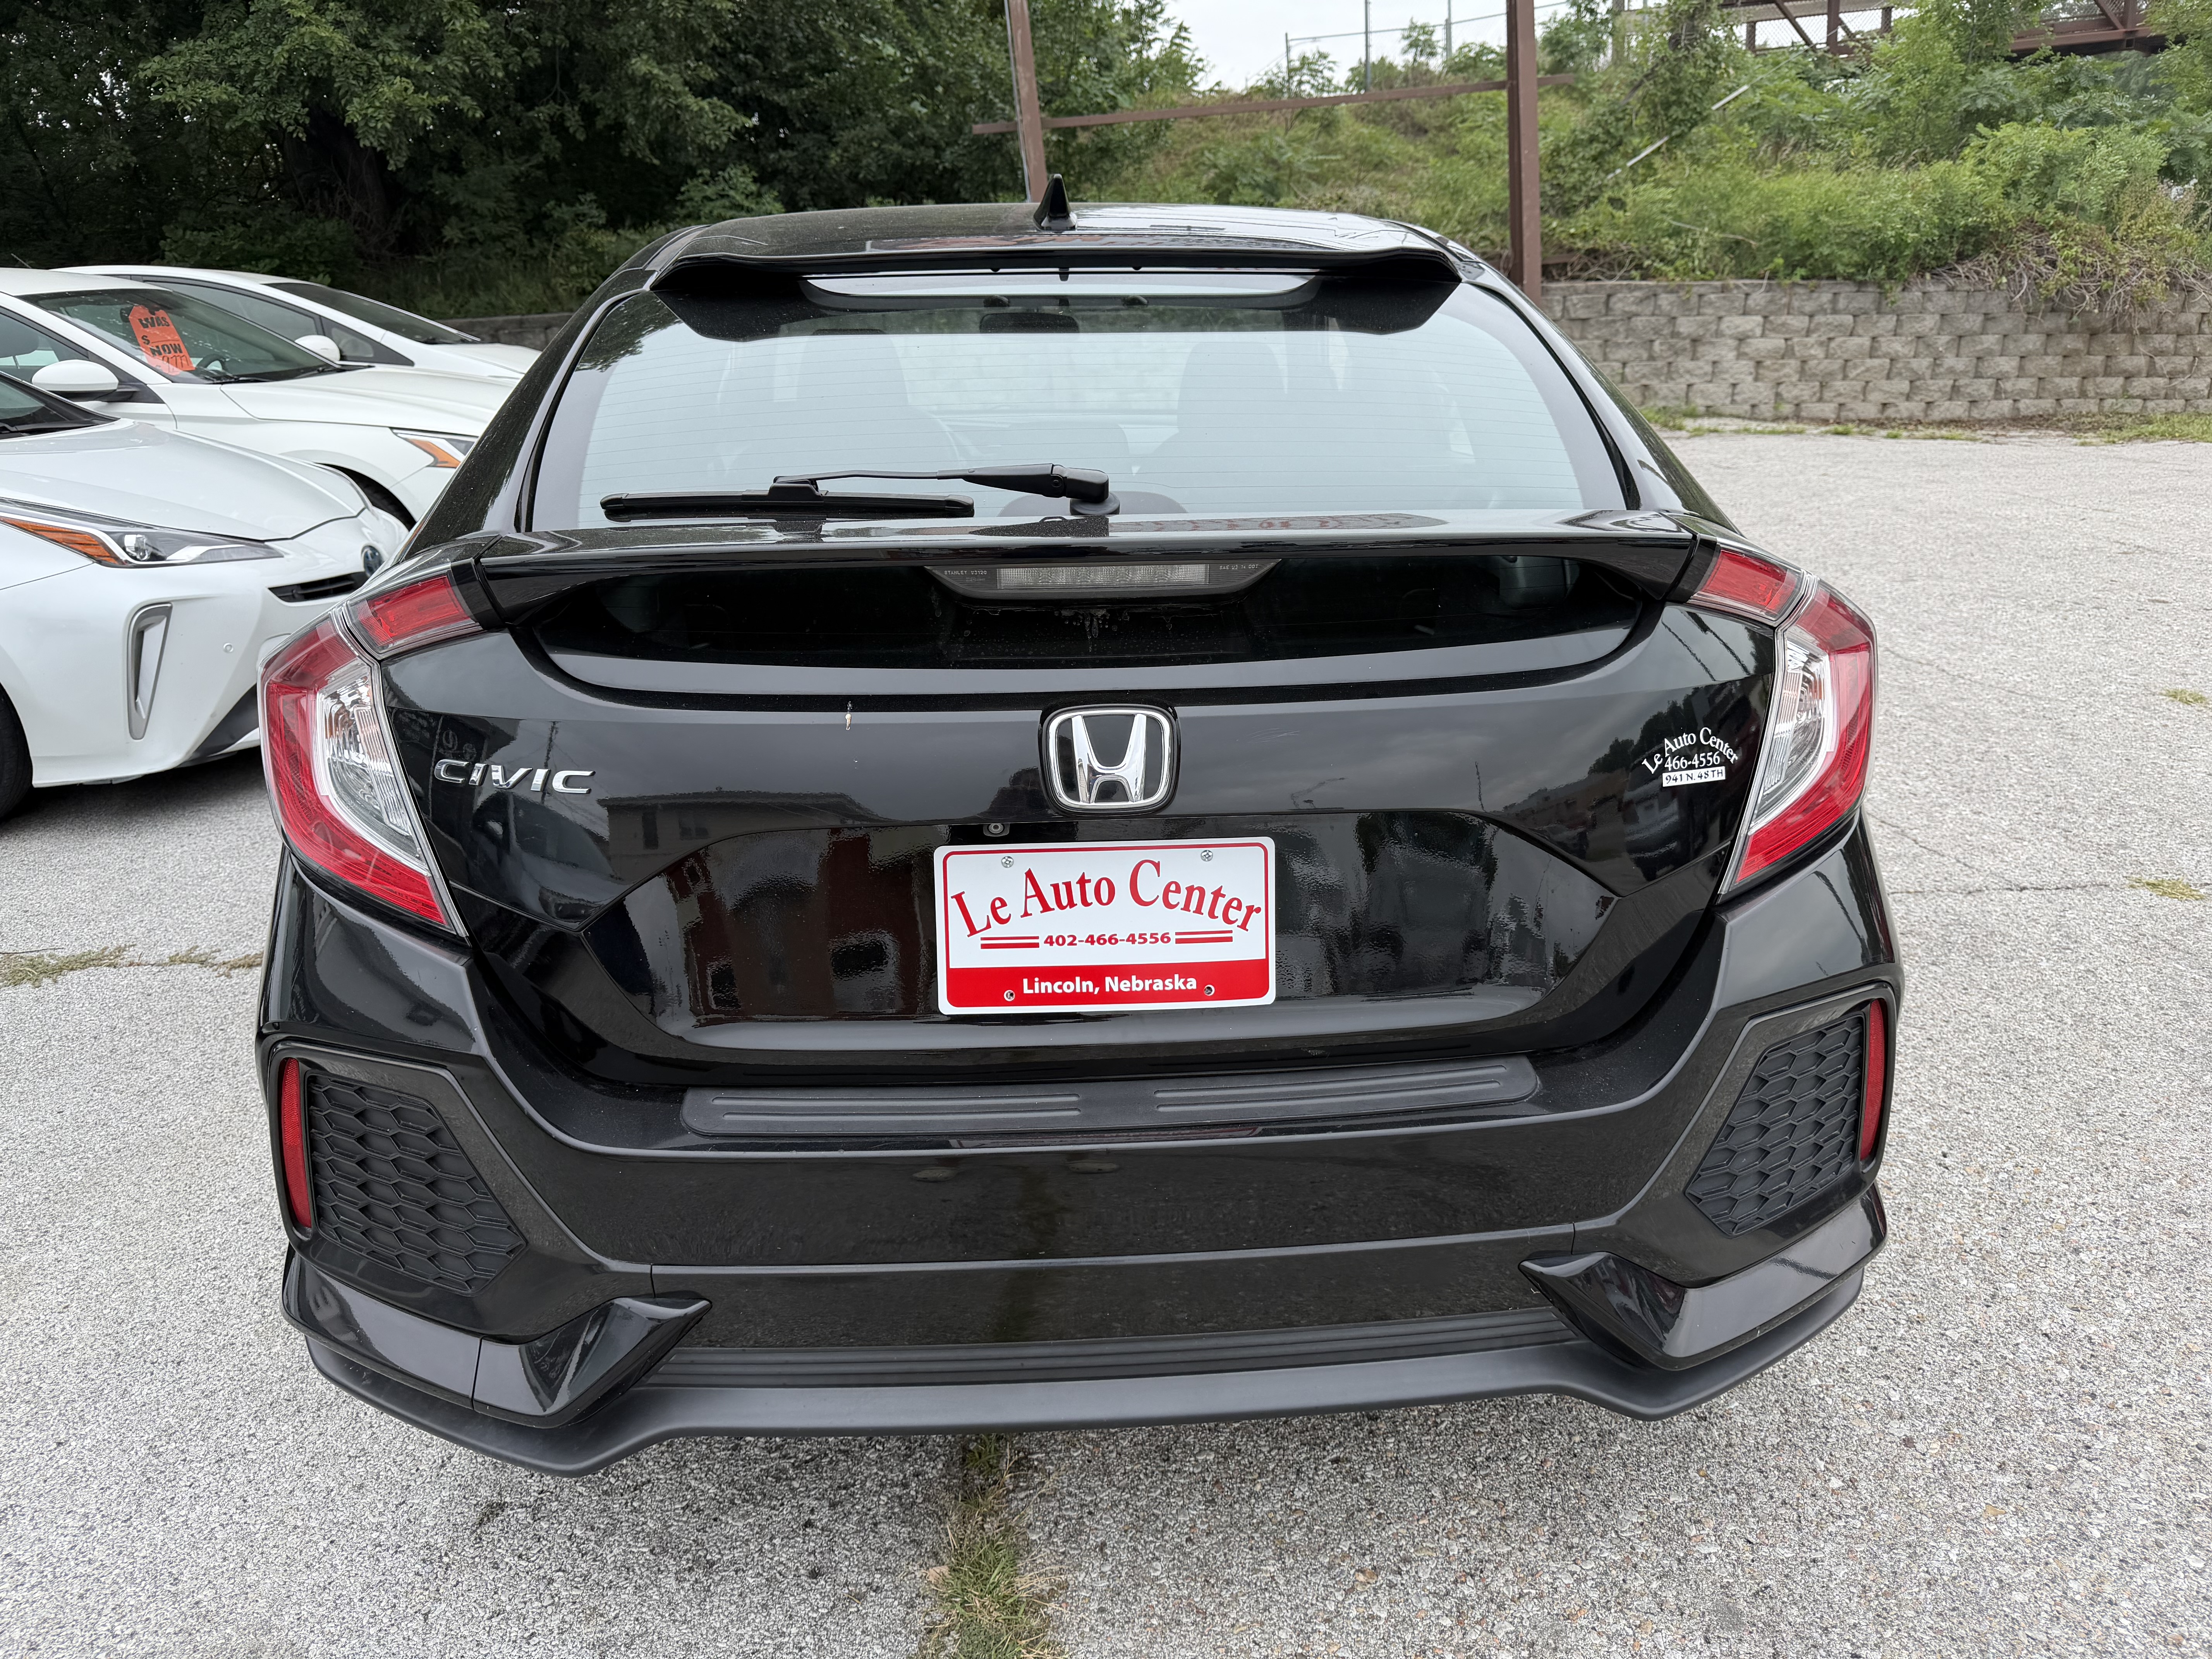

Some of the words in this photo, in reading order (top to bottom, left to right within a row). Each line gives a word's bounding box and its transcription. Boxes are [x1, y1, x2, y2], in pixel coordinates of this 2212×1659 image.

[138, 316, 170, 328] WAS
[149, 343, 183, 357] NOW
[1642, 754, 1662, 774] Le
[1664, 733, 1696, 757] Auto
[1700, 727, 1738, 764] Center
[1664, 751, 1720, 771] 466-4556
[434, 759, 596, 794] CIVIC
[1666, 774, 1683, 784] 941
[951, 891, 1011, 937] Le
[1020, 868, 1115, 919] Auto
[1129, 859, 1261, 932] Center
[1044, 933, 1171, 946] 402-466-4556
[1022, 977, 1099, 994] Lincoln,
[1105, 974, 1197, 991] Nebraska
